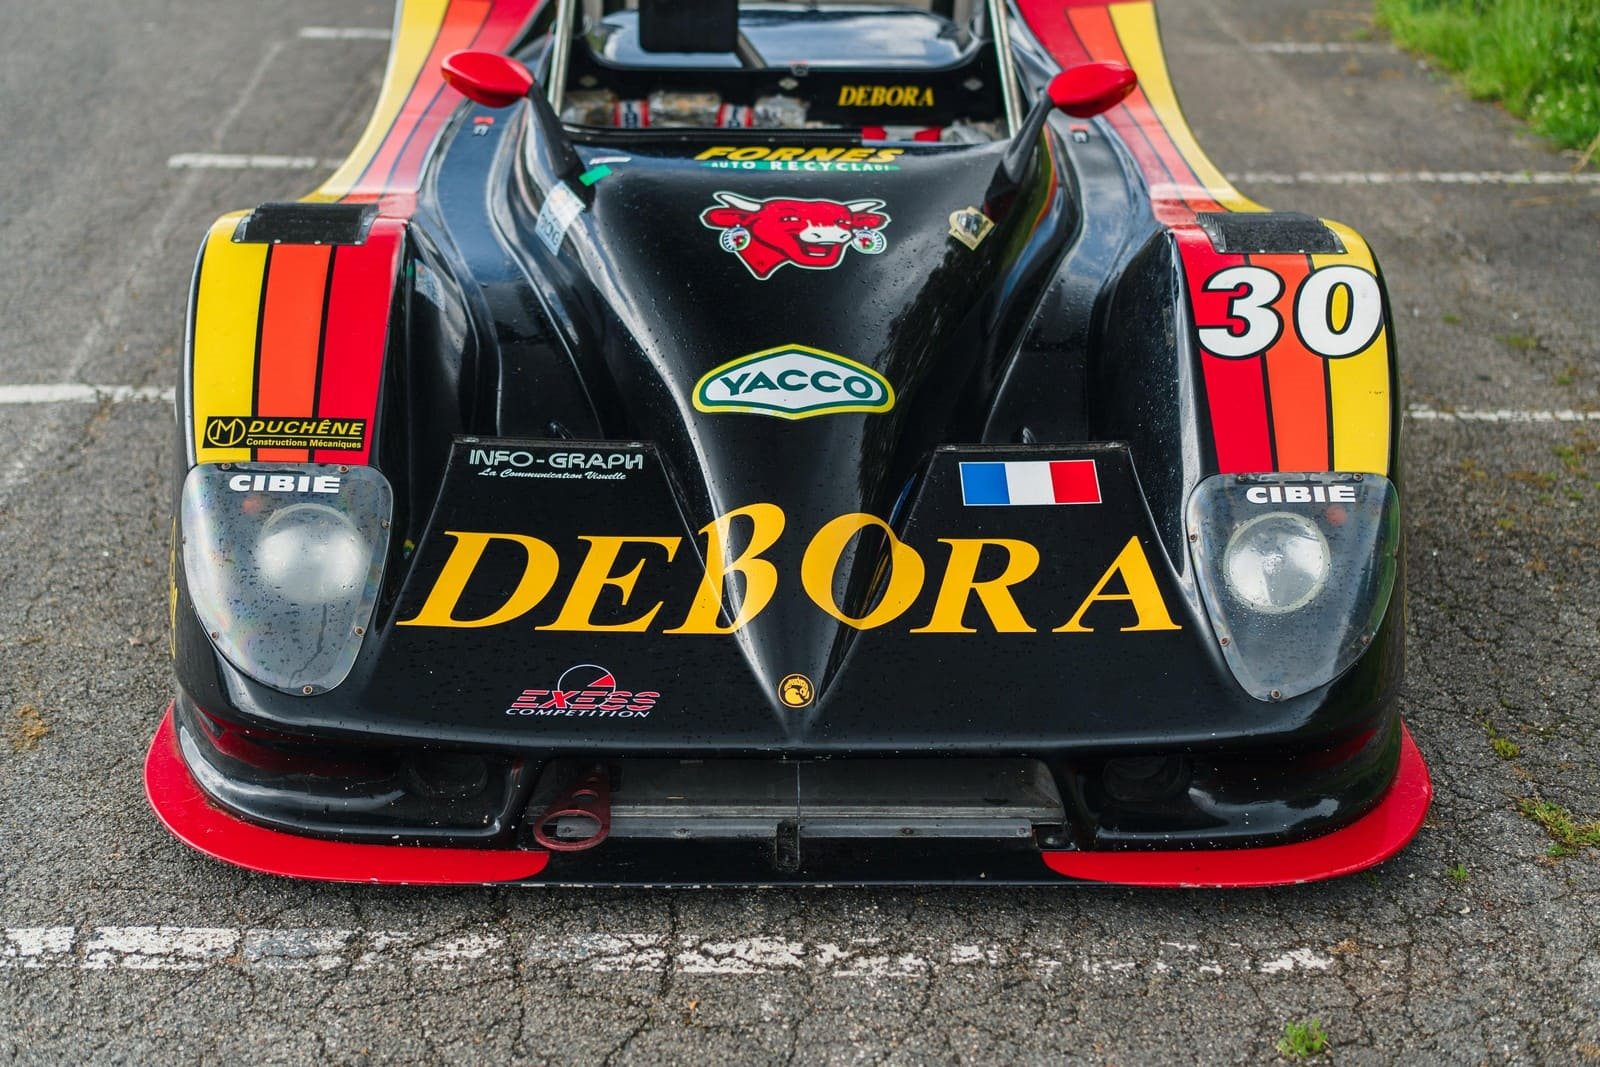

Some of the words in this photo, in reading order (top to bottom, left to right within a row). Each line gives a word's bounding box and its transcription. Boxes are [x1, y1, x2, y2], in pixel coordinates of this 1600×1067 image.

[838, 85, 934, 107] DEBORA
[694, 146, 904, 163] FORNES
[711, 161, 756, 169] AUTO
[1196, 265, 1384, 359] 30
[720, 369, 874, 399] YACCO
[248, 419, 364, 436] DUCHÊNE
[246, 438, 307, 447] Constructions
[309, 438, 362, 450] Mécaniques
[469, 449, 644, 470] INFO-GRAPH
[478, 467, 497, 477] La
[500, 468, 583, 479] Communication
[584, 471, 627, 480] Visuelle
[396, 503, 1182, 635] DEBORA
[511, 689, 661, 711] EXESS
[505, 708, 651, 718] COMPETITION
